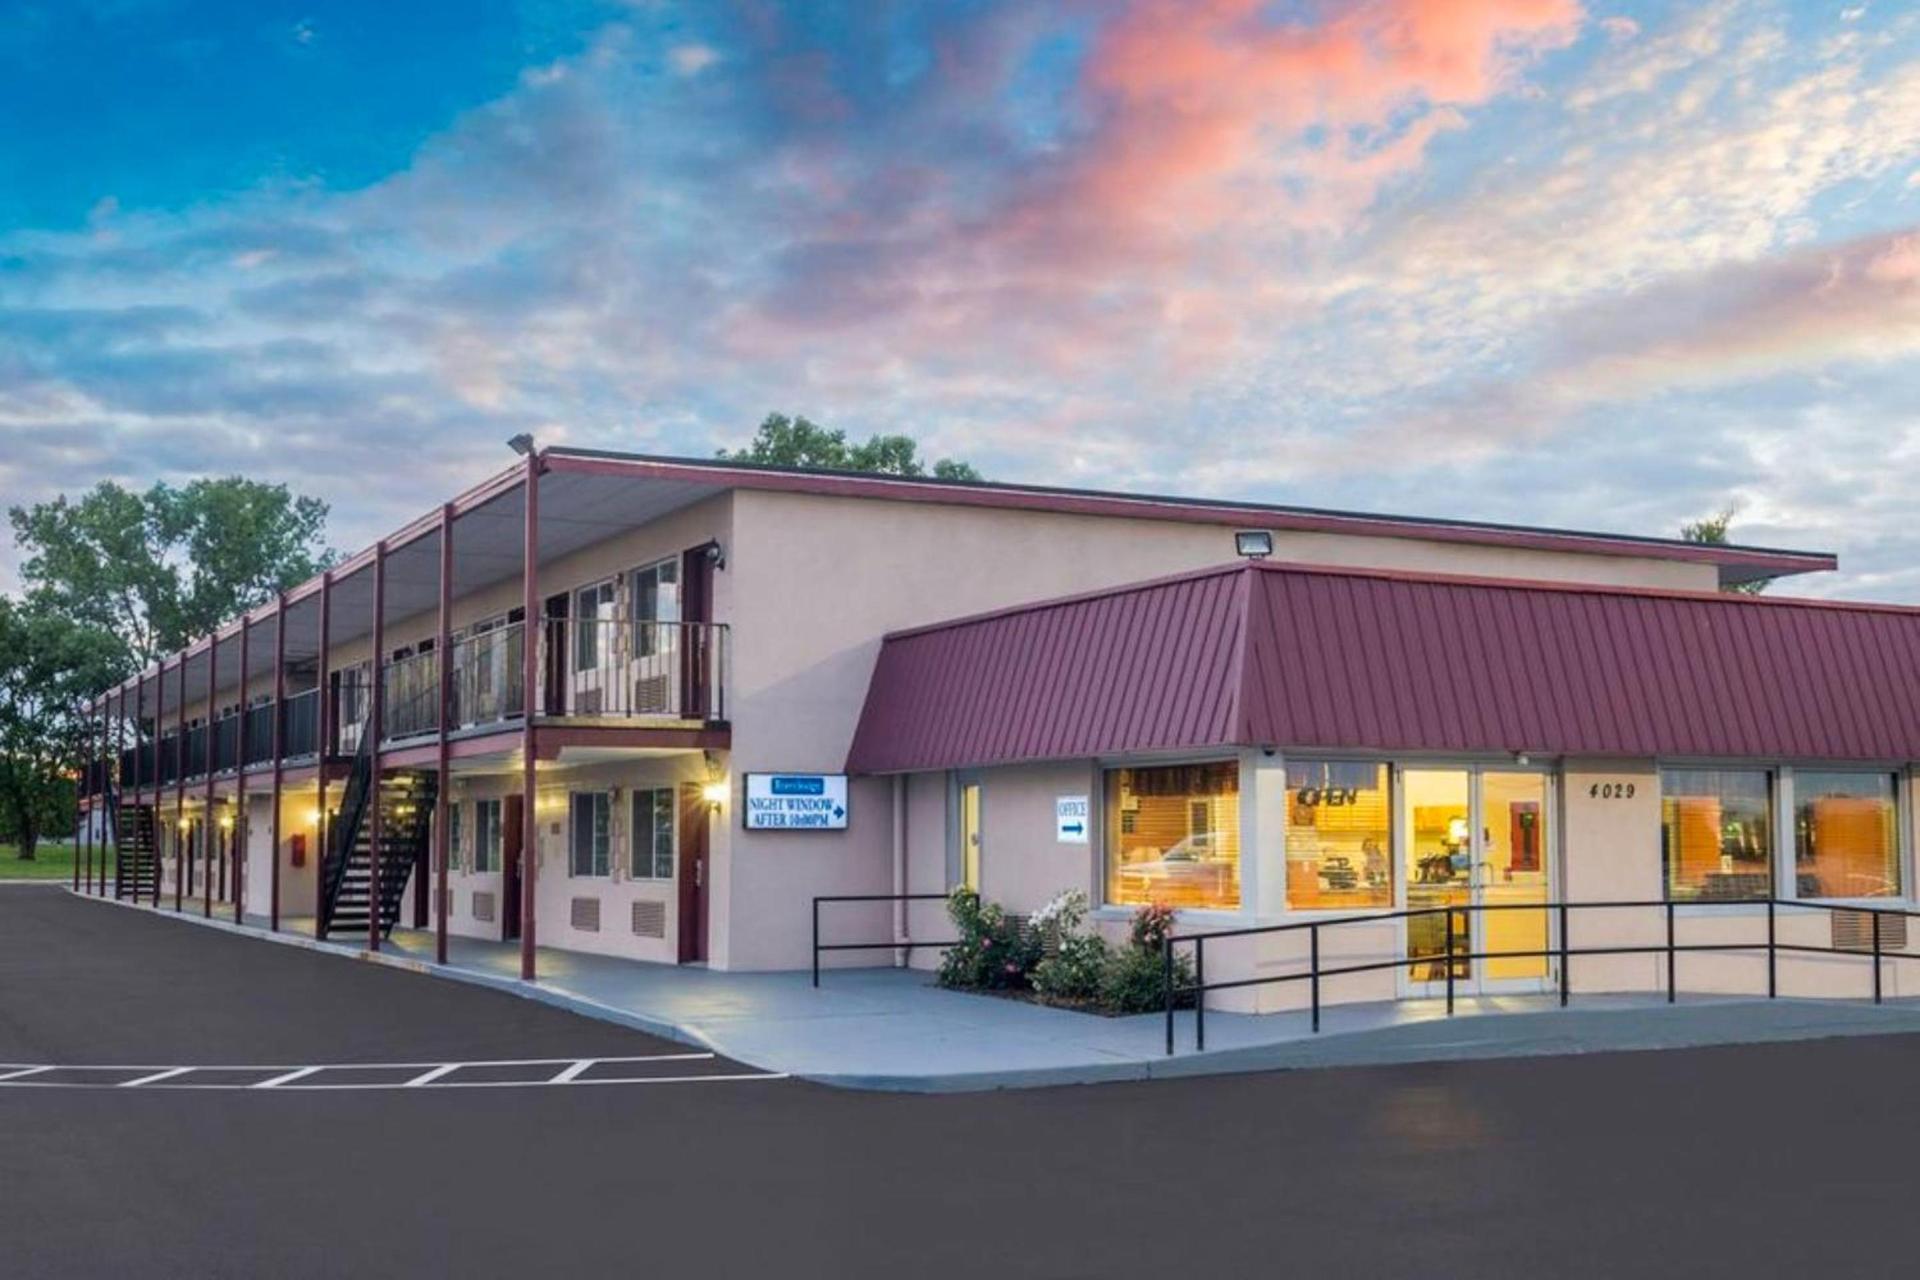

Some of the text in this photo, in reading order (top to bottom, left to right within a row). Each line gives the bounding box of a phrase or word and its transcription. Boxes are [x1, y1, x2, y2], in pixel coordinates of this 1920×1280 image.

[1296, 787, 1358, 807] OPEN
[1589, 783, 1635, 799] 4029
[750, 798, 834, 811] NIGHT WINDOW
[1058, 801, 1086, 817] OFFICE
[755, 813, 786, 826] AFTER
